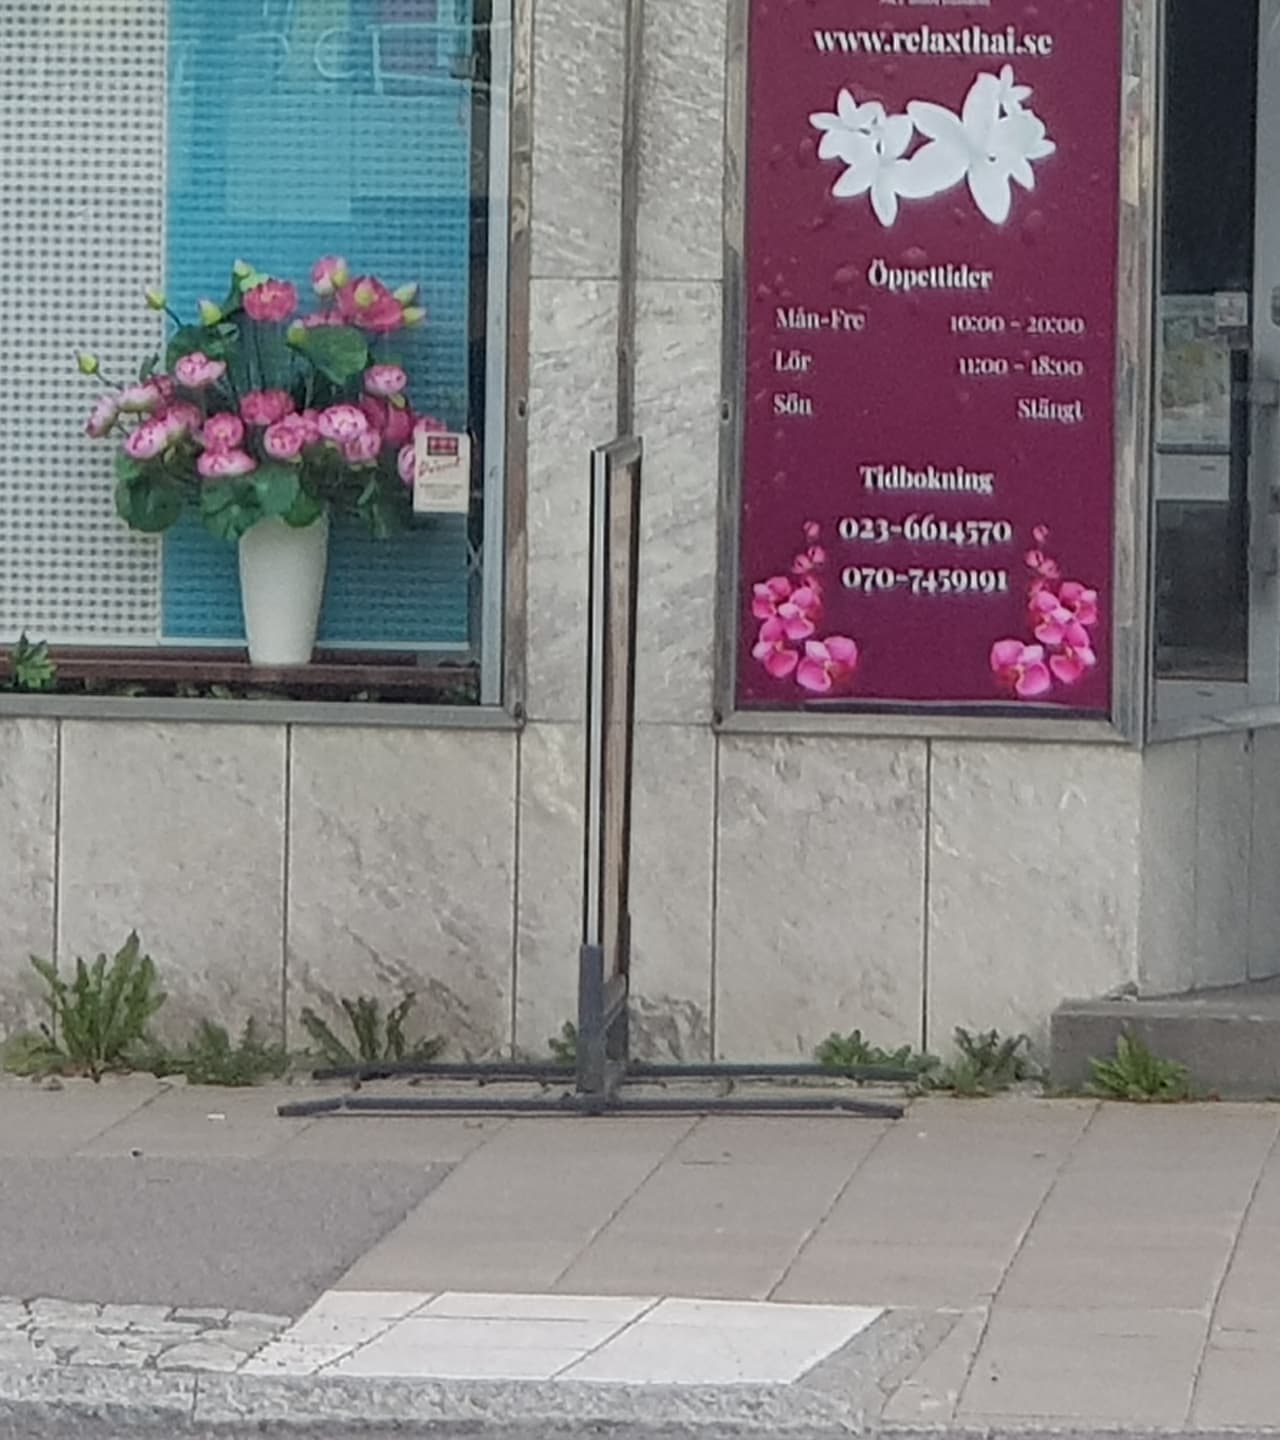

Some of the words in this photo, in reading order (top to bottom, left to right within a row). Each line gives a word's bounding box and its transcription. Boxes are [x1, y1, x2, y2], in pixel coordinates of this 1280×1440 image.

[814, 25, 1053, 55] www.relaxthai.se
[868, 259, 993, 292] Öppettider
[776, 306, 865, 331] Mån-Fre
[951, 315, 1006, 333] 10:00
[775, 350, 812, 372] Lör
[773, 393, 813, 416] Sön
[1017, 398, 1083, 424] Stängt
[860, 465, 994, 495] Tidbokning
[839, 514, 1012, 547] 023-6614570
[842, 567, 1008, 594] 070-7459191
